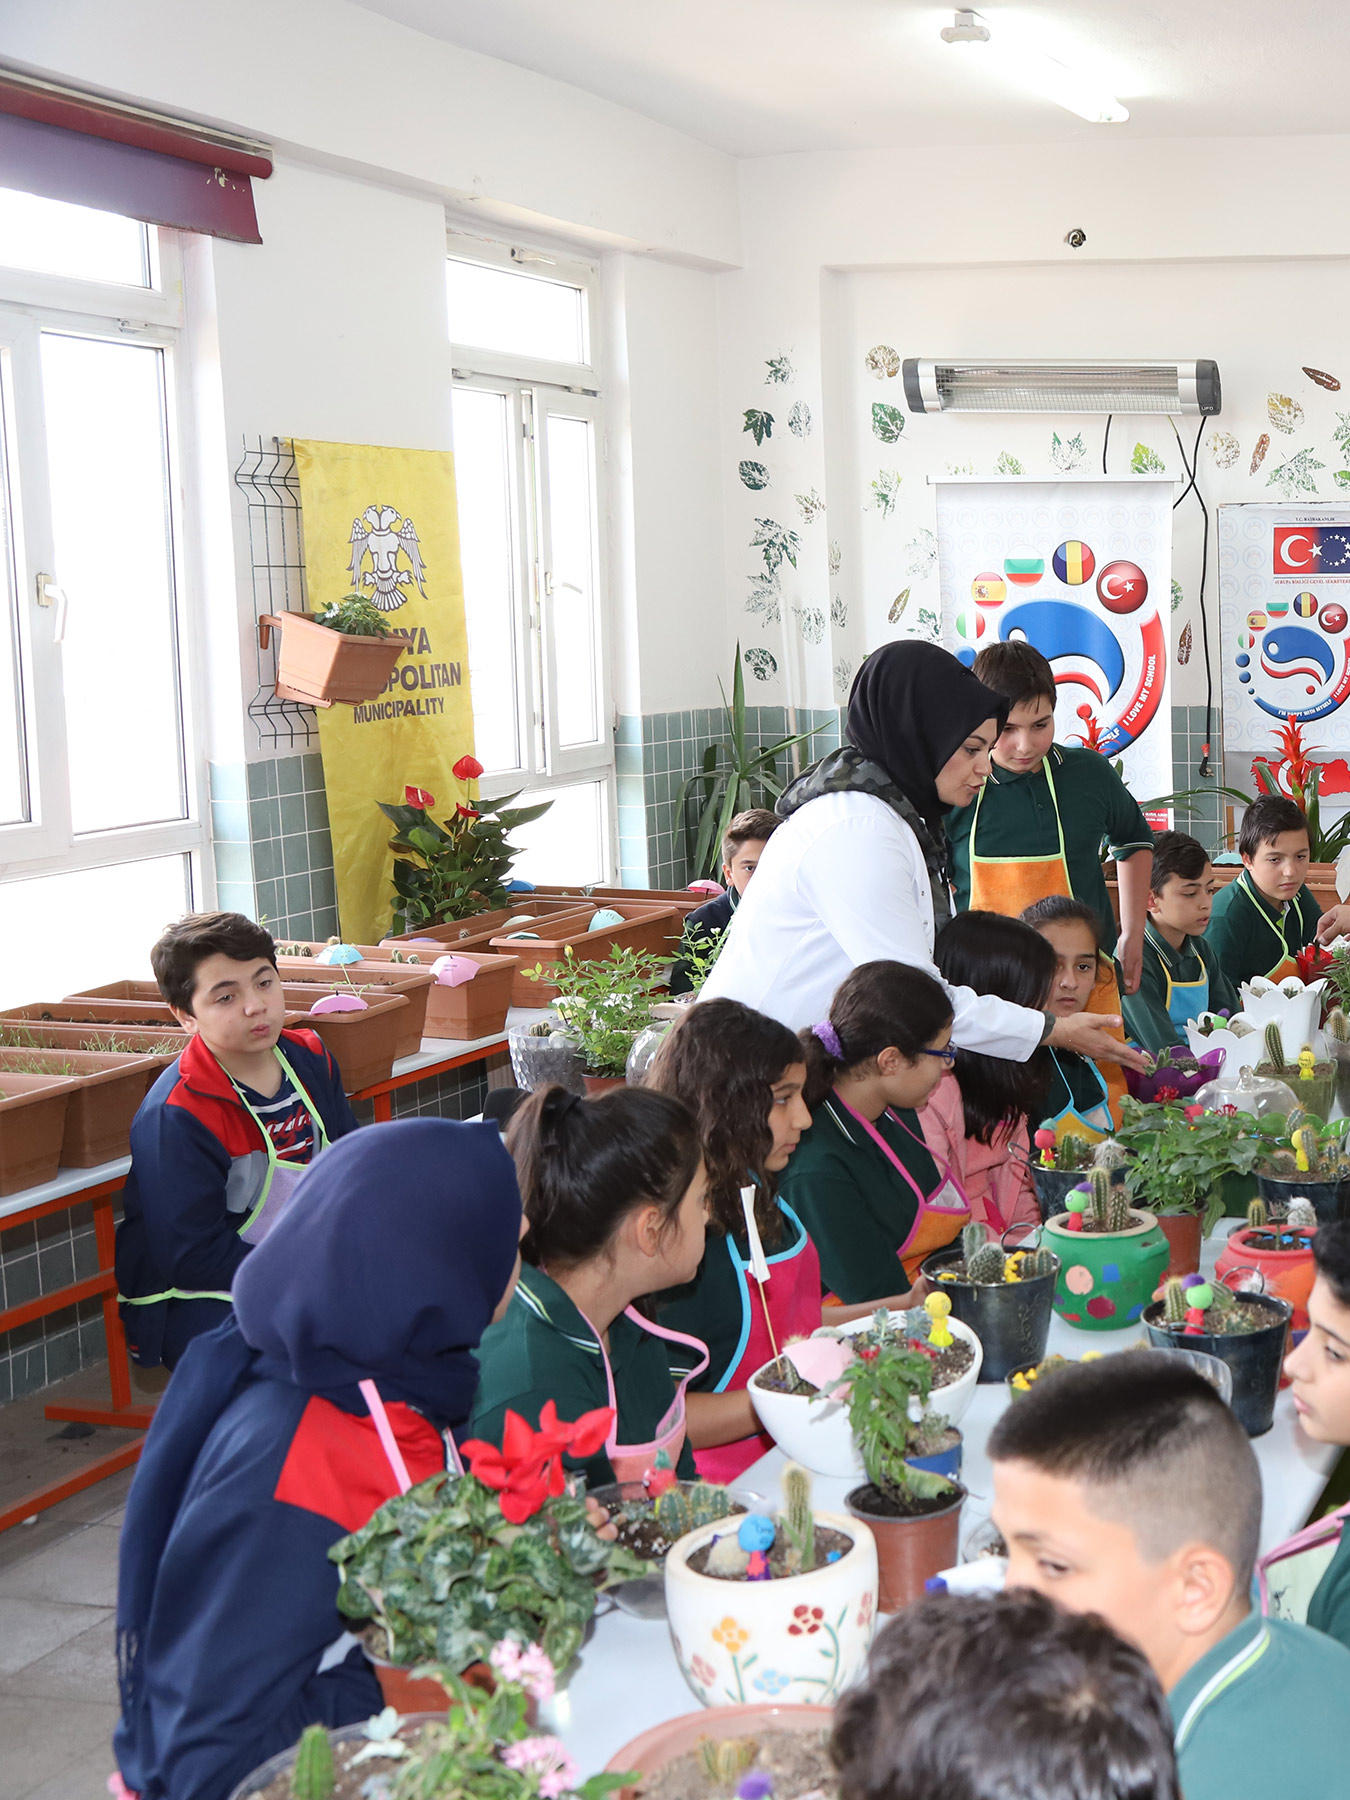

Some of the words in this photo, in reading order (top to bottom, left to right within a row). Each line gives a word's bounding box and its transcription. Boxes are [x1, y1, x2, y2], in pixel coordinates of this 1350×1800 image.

[353, 697, 444, 724] MUNICIPALITY
[1126, 701, 1144, 722] LOVE
[1138, 687, 1150, 702] MY
[1144, 654, 1156, 688] SCHOOL
